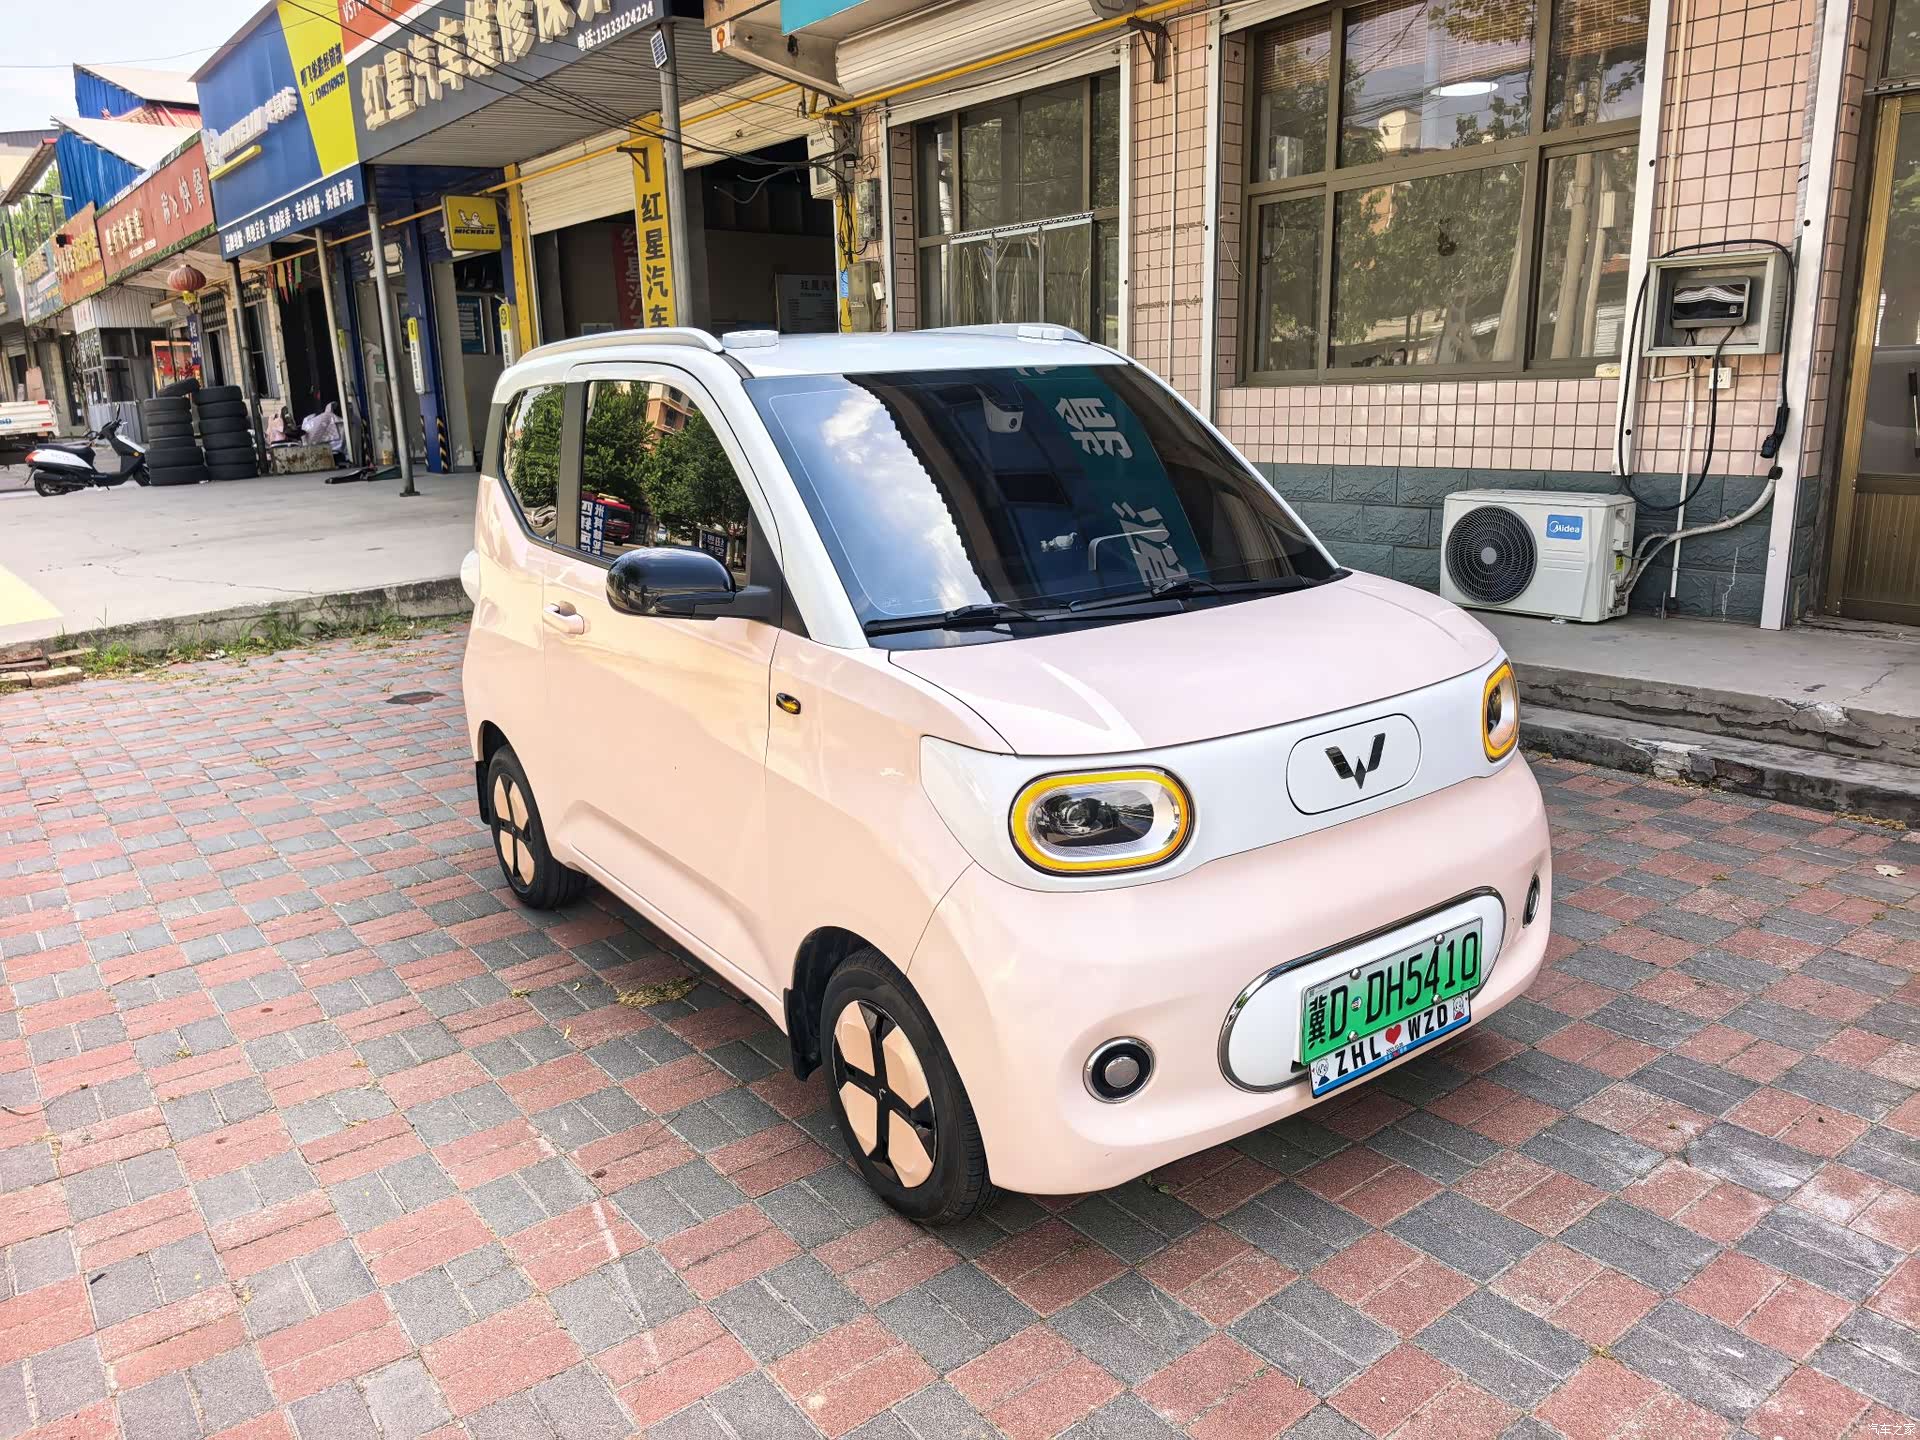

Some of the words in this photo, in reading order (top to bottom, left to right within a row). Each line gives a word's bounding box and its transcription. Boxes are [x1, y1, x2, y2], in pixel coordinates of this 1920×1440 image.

[641, 192, 669, 328] 红星汽车
[1550, 521, 1580, 534] Midea
[1365, 931, 1478, 1025] DH5410
[1335, 1036, 1382, 1078] ZHL
[1407, 1004, 1448, 1042] WZD
